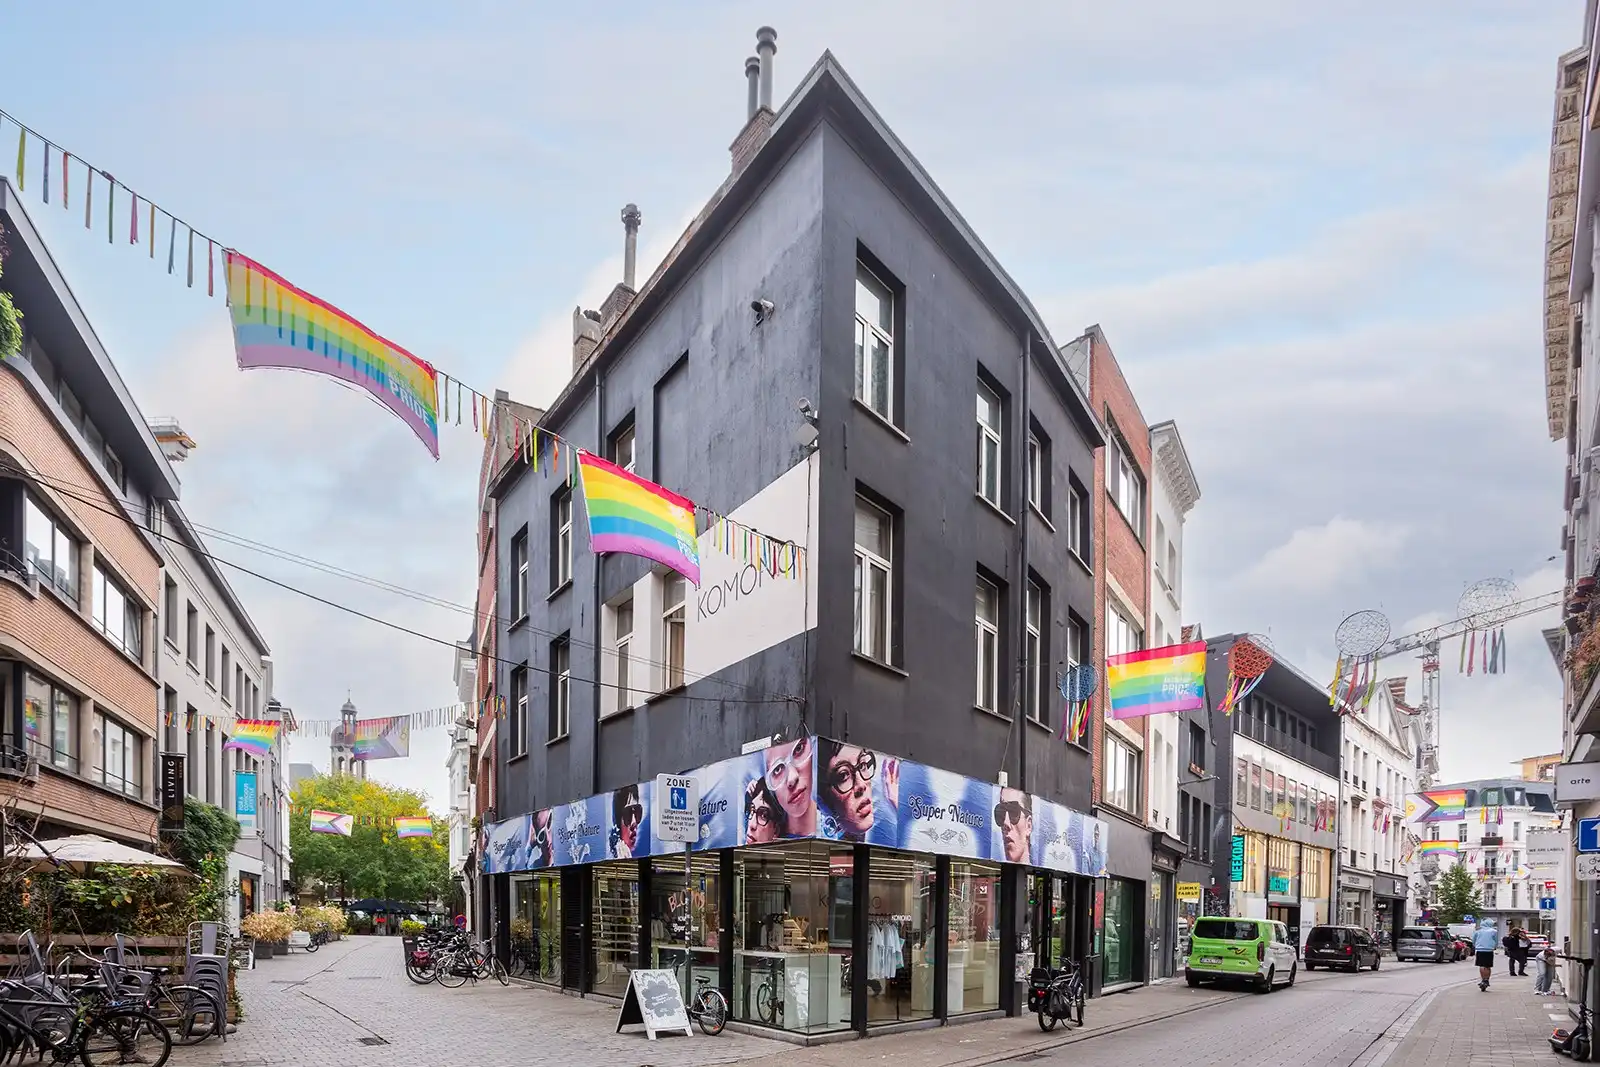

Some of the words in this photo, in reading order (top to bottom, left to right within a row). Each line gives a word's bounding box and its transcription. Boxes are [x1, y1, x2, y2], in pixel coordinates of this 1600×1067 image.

[388, 378, 430, 428] PRIDE
[697, 540, 796, 623] KOMONO
[167, 760, 175, 798] LIVING
[666, 777, 691, 788] ZONE
[908, 795, 945, 821] Super
[948, 804, 984, 827] Nature
[558, 826, 577, 843] Super
[577, 823, 600, 836] Nature
[1232, 836, 1243, 881] WEEKDAY
